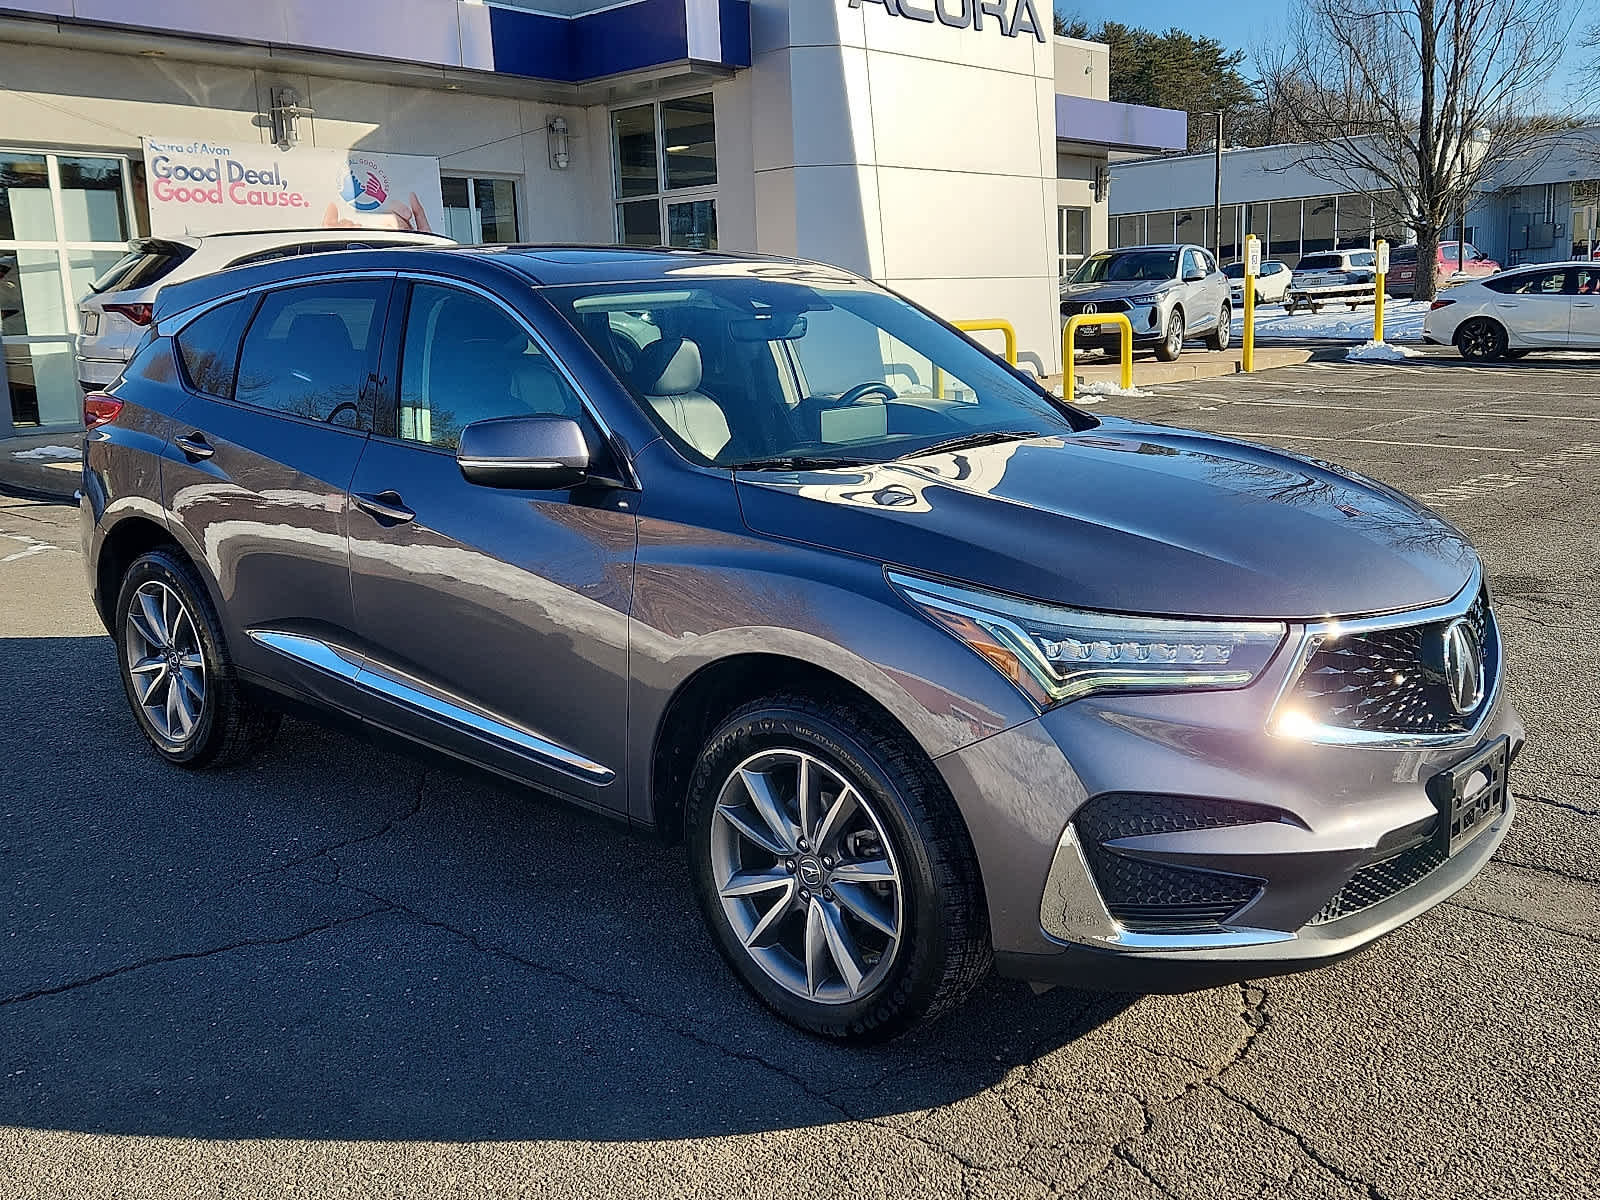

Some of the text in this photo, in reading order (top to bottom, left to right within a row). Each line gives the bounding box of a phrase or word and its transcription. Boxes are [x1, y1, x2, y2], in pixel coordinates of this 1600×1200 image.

[186, 142, 199, 154] of
[200, 143, 231, 156] Avon
[151, 155, 288, 191] Good Deal,
[152, 177, 310, 208] Good Cause.
